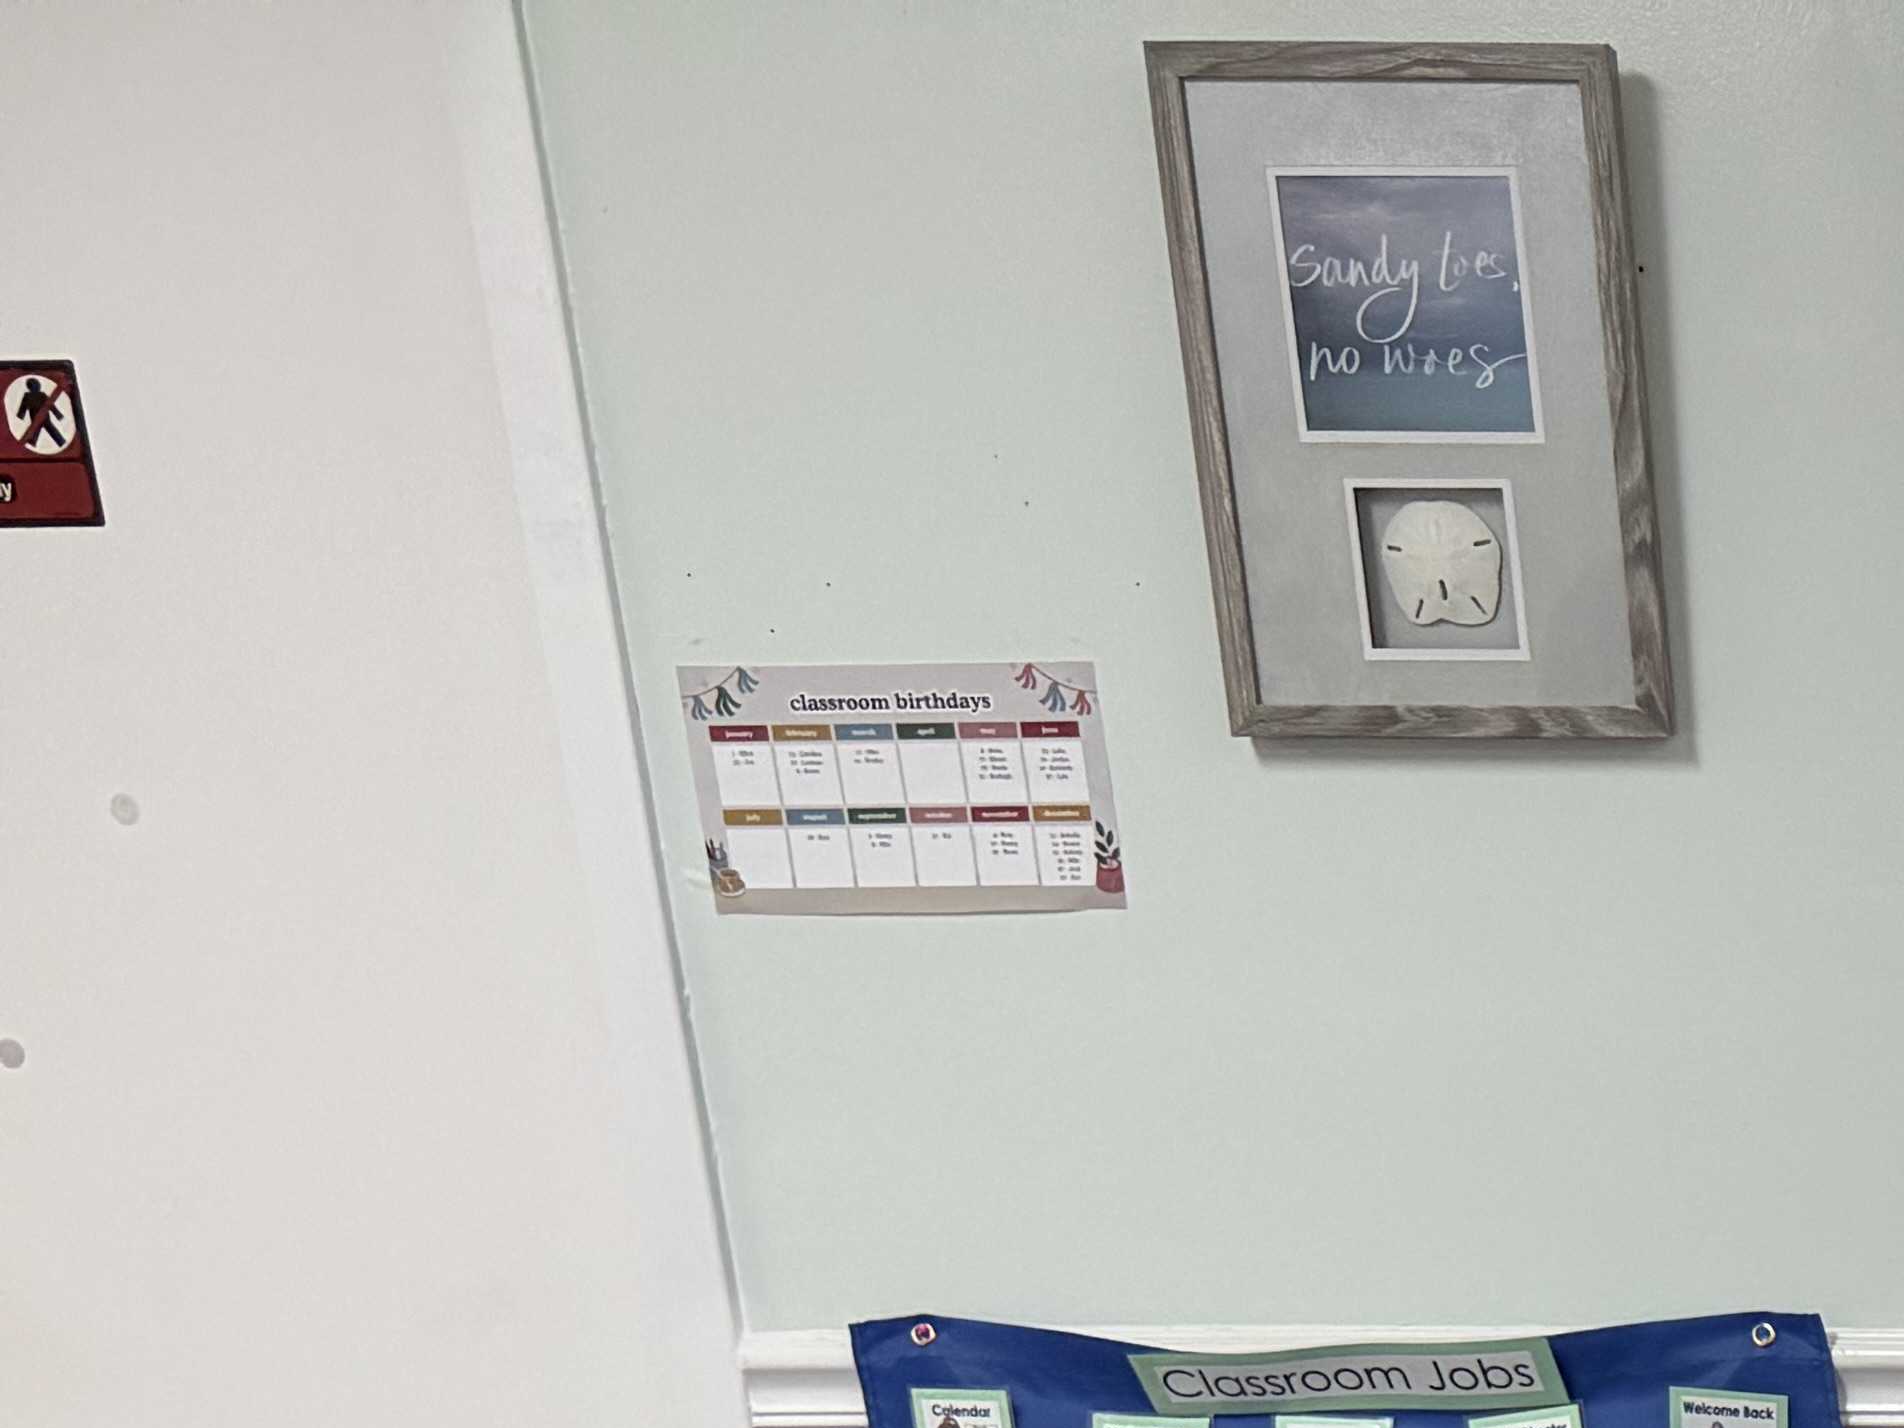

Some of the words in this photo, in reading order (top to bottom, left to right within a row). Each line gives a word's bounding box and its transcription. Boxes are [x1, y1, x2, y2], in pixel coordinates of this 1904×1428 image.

[1290, 234, 1420, 343] Sandy
[1309, 341, 1361, 381] no
[790, 694, 890, 713] classroom
[894, 691, 992, 714] birthdays
[1162, 1362, 1412, 1399] Classroom
[1428, 1359, 1536, 1392] Jobs
[932, 1404, 991, 1419] Calendar
[1683, 1401, 1741, 1418] Welcome
[1743, 1406, 1775, 1420] Back
